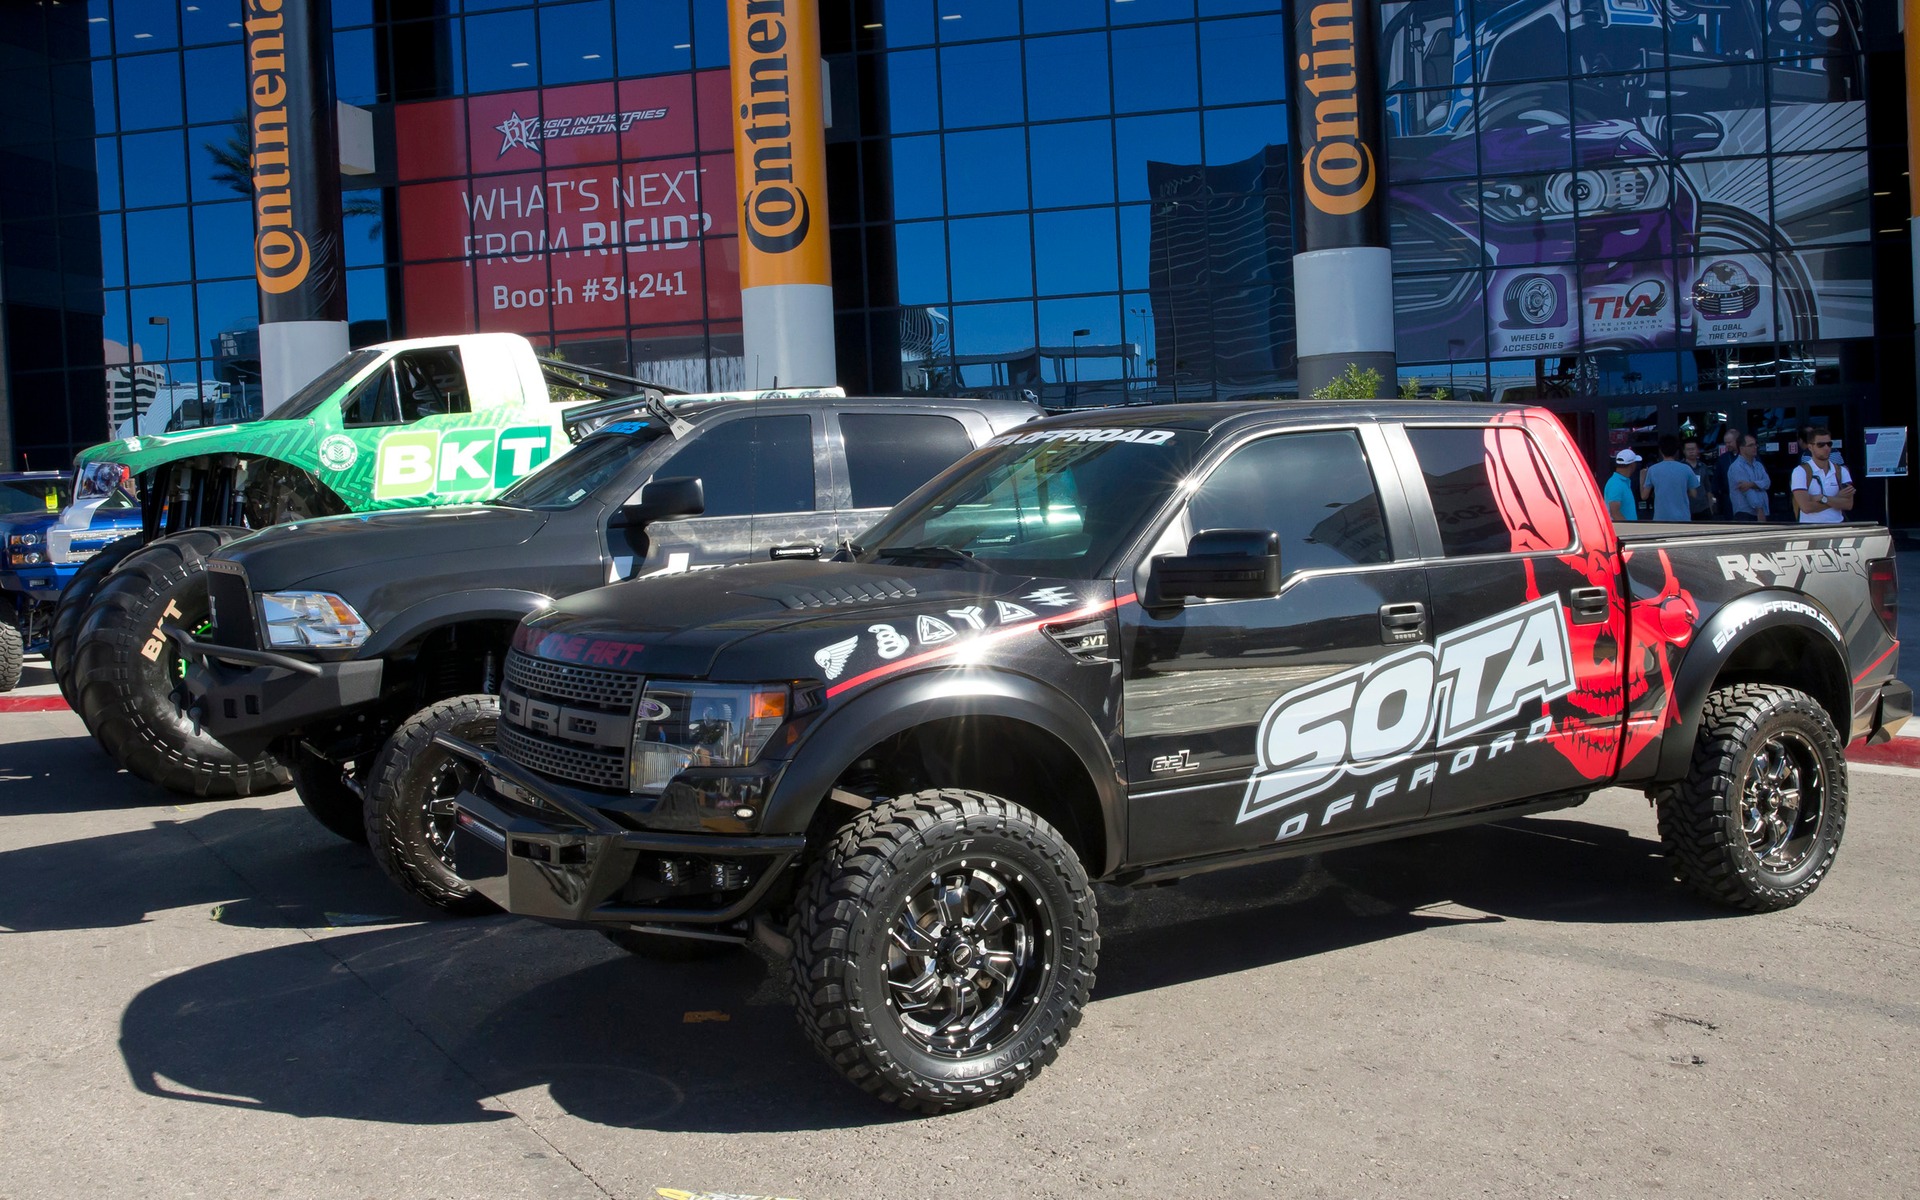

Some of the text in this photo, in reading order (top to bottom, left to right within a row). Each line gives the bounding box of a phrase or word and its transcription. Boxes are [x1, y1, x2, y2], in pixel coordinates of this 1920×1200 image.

[561, 123, 631, 137] LIGHTING
[574, 108, 668, 126] INDUSTRIES
[462, 169, 707, 222] WHAT'S NEXT
[464, 212, 712, 267] FROM RIGID?
[493, 271, 688, 310] Booth #34241
[1588, 293, 1658, 321] TIA
[1510, 332, 1555, 342] WHEELS &
[1708, 331, 1748, 341] TIRE EXPO
[1711, 323, 1743, 332] GLOBAL
[1502, 341, 1564, 352] ACCESSORIES
[1013, 428, 1176, 446] OFFROAD
[381, 436, 547, 486] BKT
[140, 598, 183, 663] BKT
[1081, 634, 1106, 647] SVT
[582, 640, 646, 667] ART
[1235, 591, 1577, 826] SOTA
[1150, 749, 1200, 773] 6.2L
[1274, 714, 1553, 842] OFFROAD
[944, 926, 1075, 1079] OPEN COUNTRY
